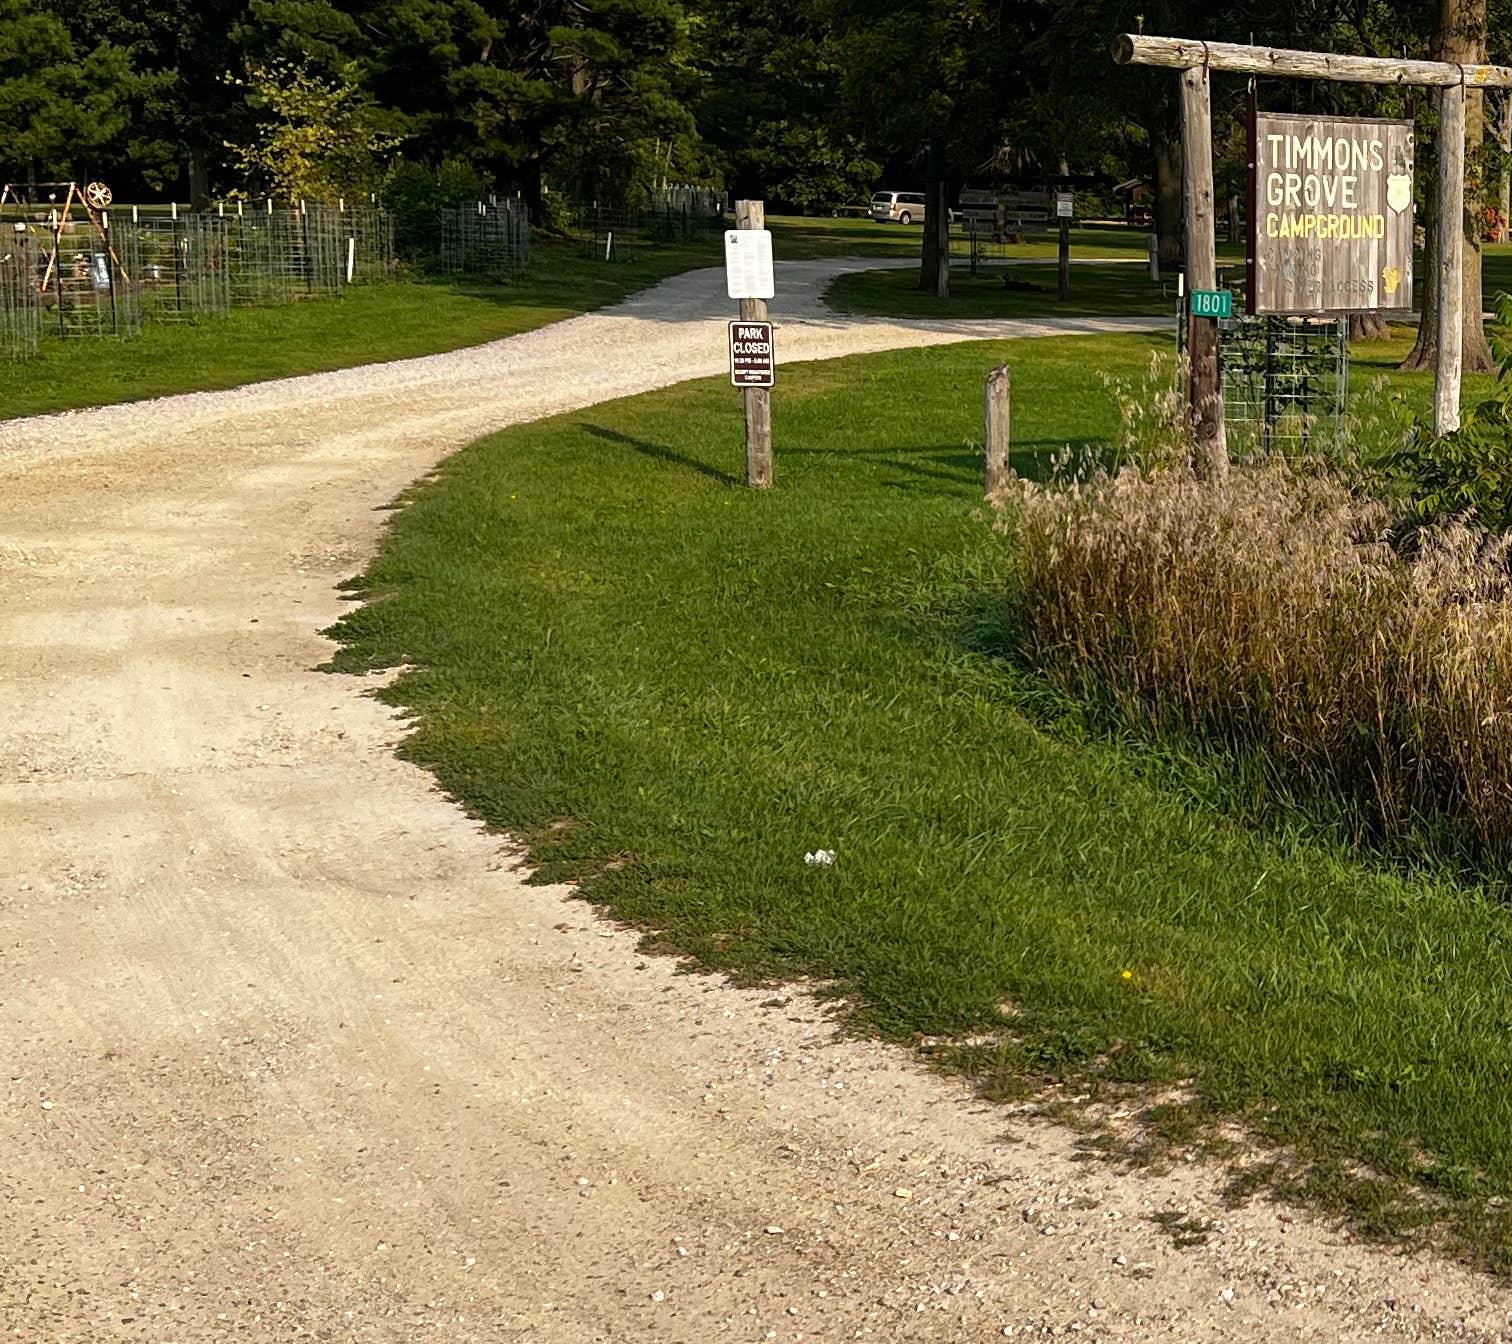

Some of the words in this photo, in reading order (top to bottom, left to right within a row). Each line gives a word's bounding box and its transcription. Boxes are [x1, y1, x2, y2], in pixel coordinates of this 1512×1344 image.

[1267, 134, 1384, 172] TIMMONS
[1267, 172, 1358, 209] GROVE
[1266, 212, 1385, 240] CAMPGROUND
[1197, 294, 1227, 313] 1801
[738, 327, 764, 340] PARK
[733, 341, 770, 354] CLOSED
